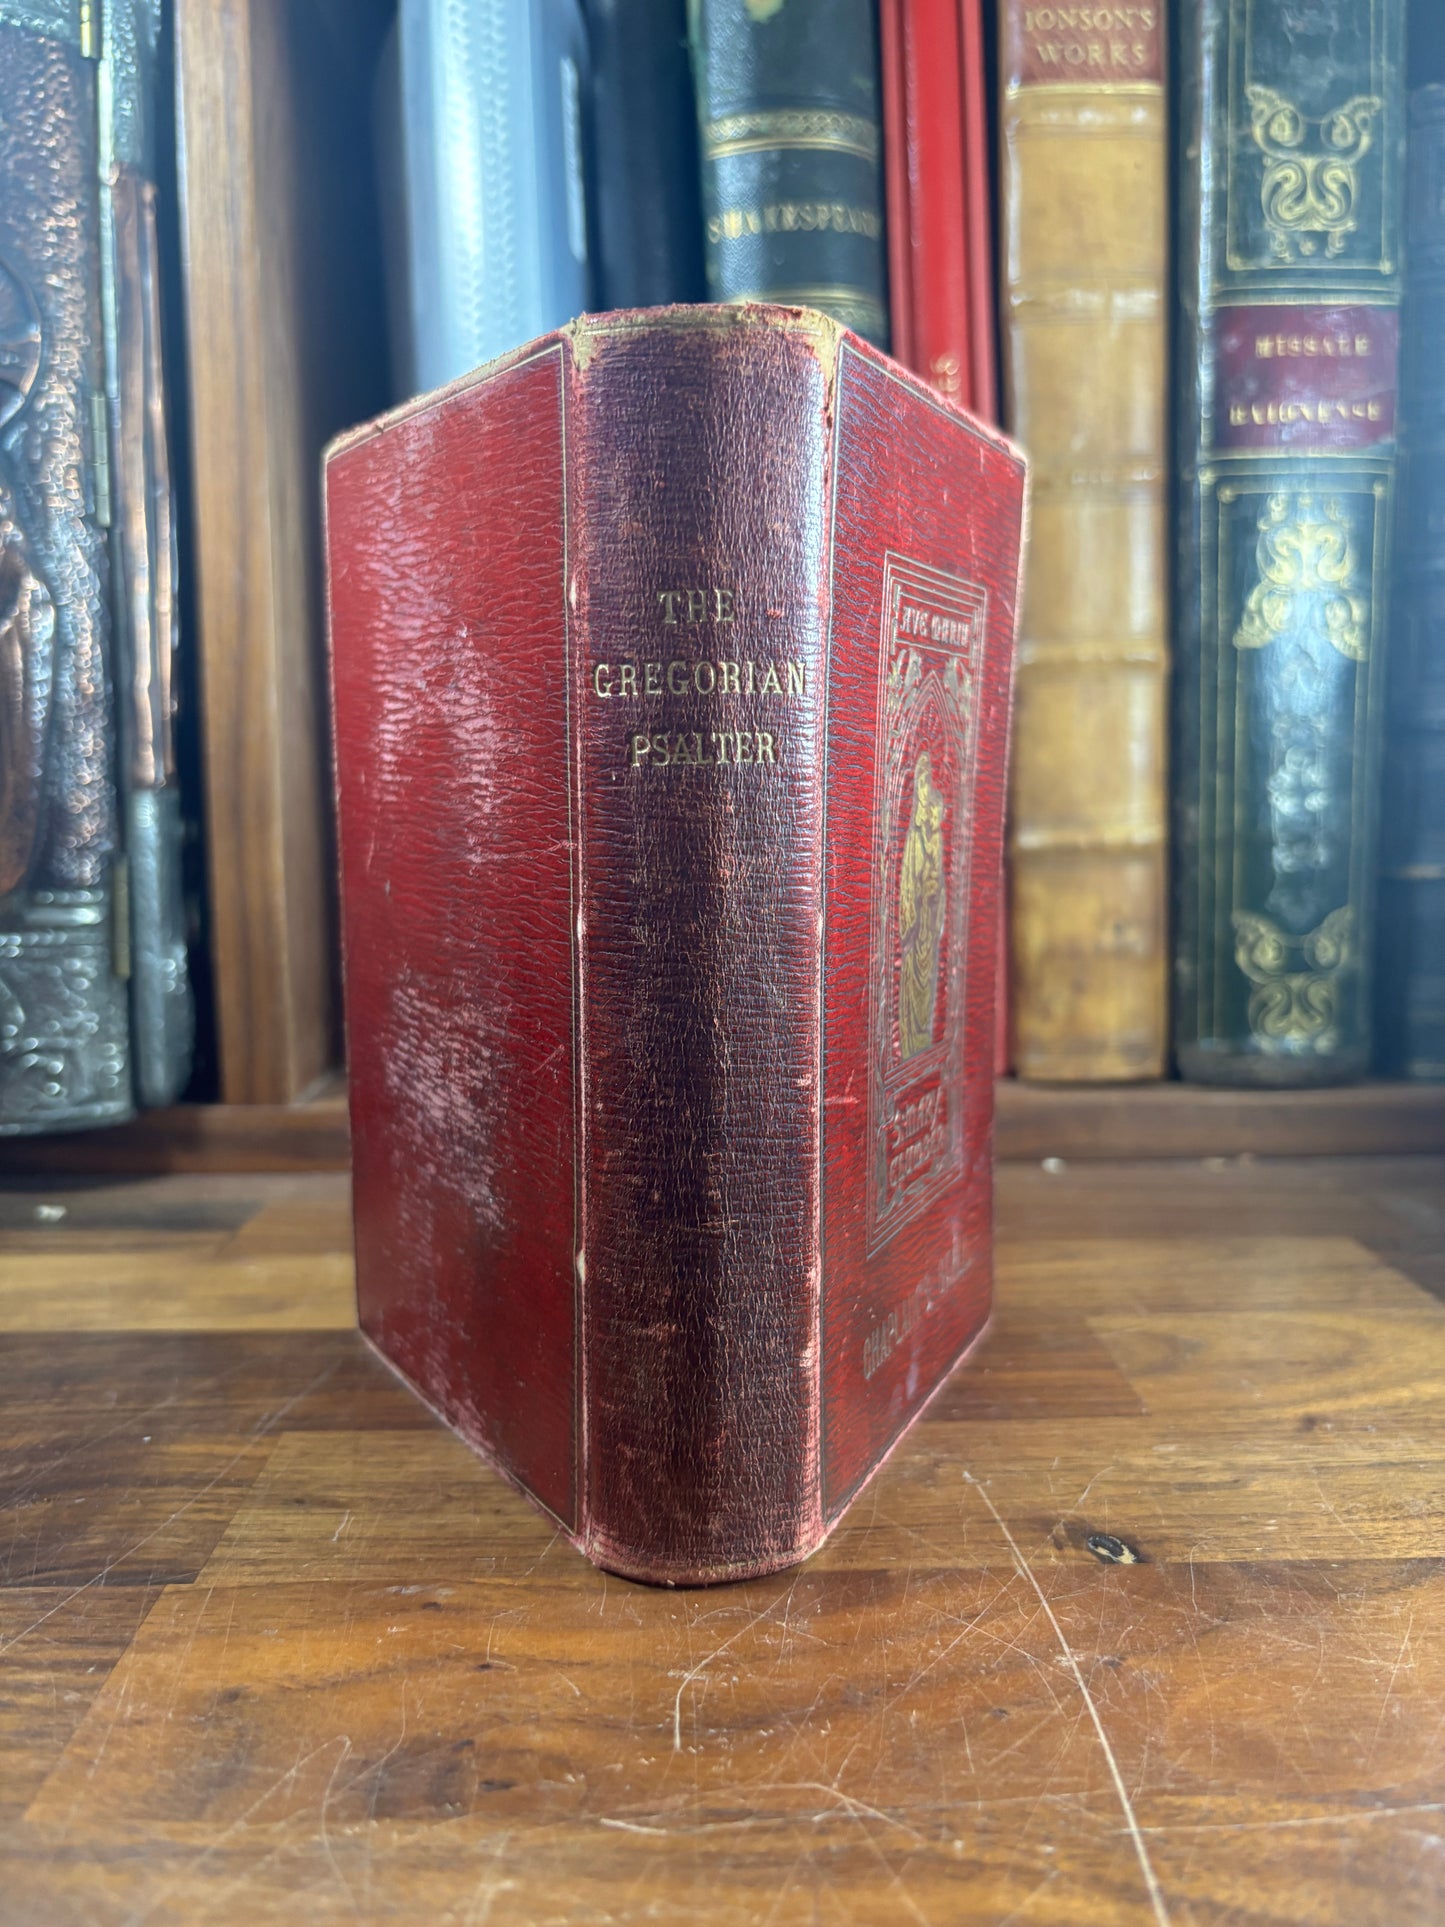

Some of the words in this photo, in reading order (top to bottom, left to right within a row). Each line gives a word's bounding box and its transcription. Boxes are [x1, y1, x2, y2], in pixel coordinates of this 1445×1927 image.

[1036, 43, 1147, 65] WORKS
[657, 588, 736, 624] THE
[593, 659, 807, 698] GREGORIAN
[631, 731, 776, 768] PSALTER
